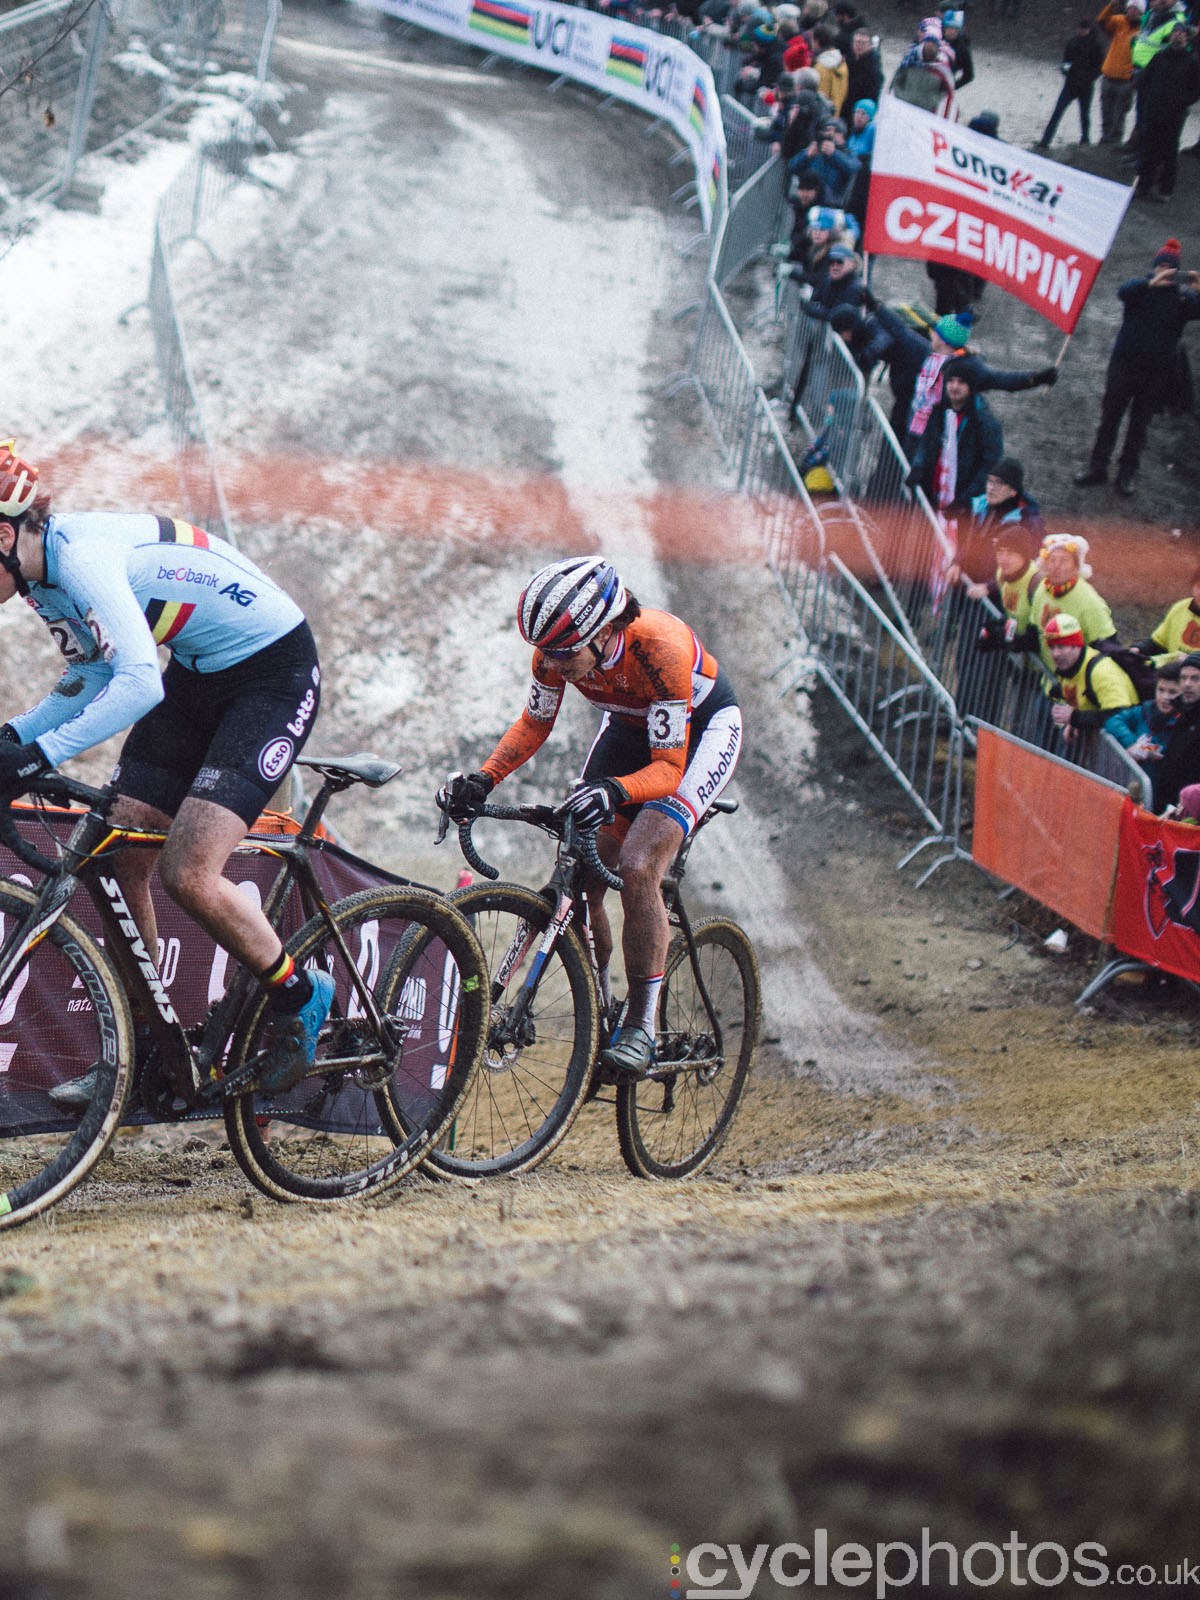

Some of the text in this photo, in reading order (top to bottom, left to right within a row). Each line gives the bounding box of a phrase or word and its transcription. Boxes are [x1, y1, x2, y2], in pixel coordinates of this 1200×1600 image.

[533, 10, 574, 57] UCI
[885, 196, 1082, 314] CZEMPIŃ
[575, 604, 593, 626] GIRO
[50, 626, 79, 656] 2
[654, 708, 671, 740] 3
[696, 721, 741, 806] Rabobank
[99, 875, 180, 1025] STEVENS
